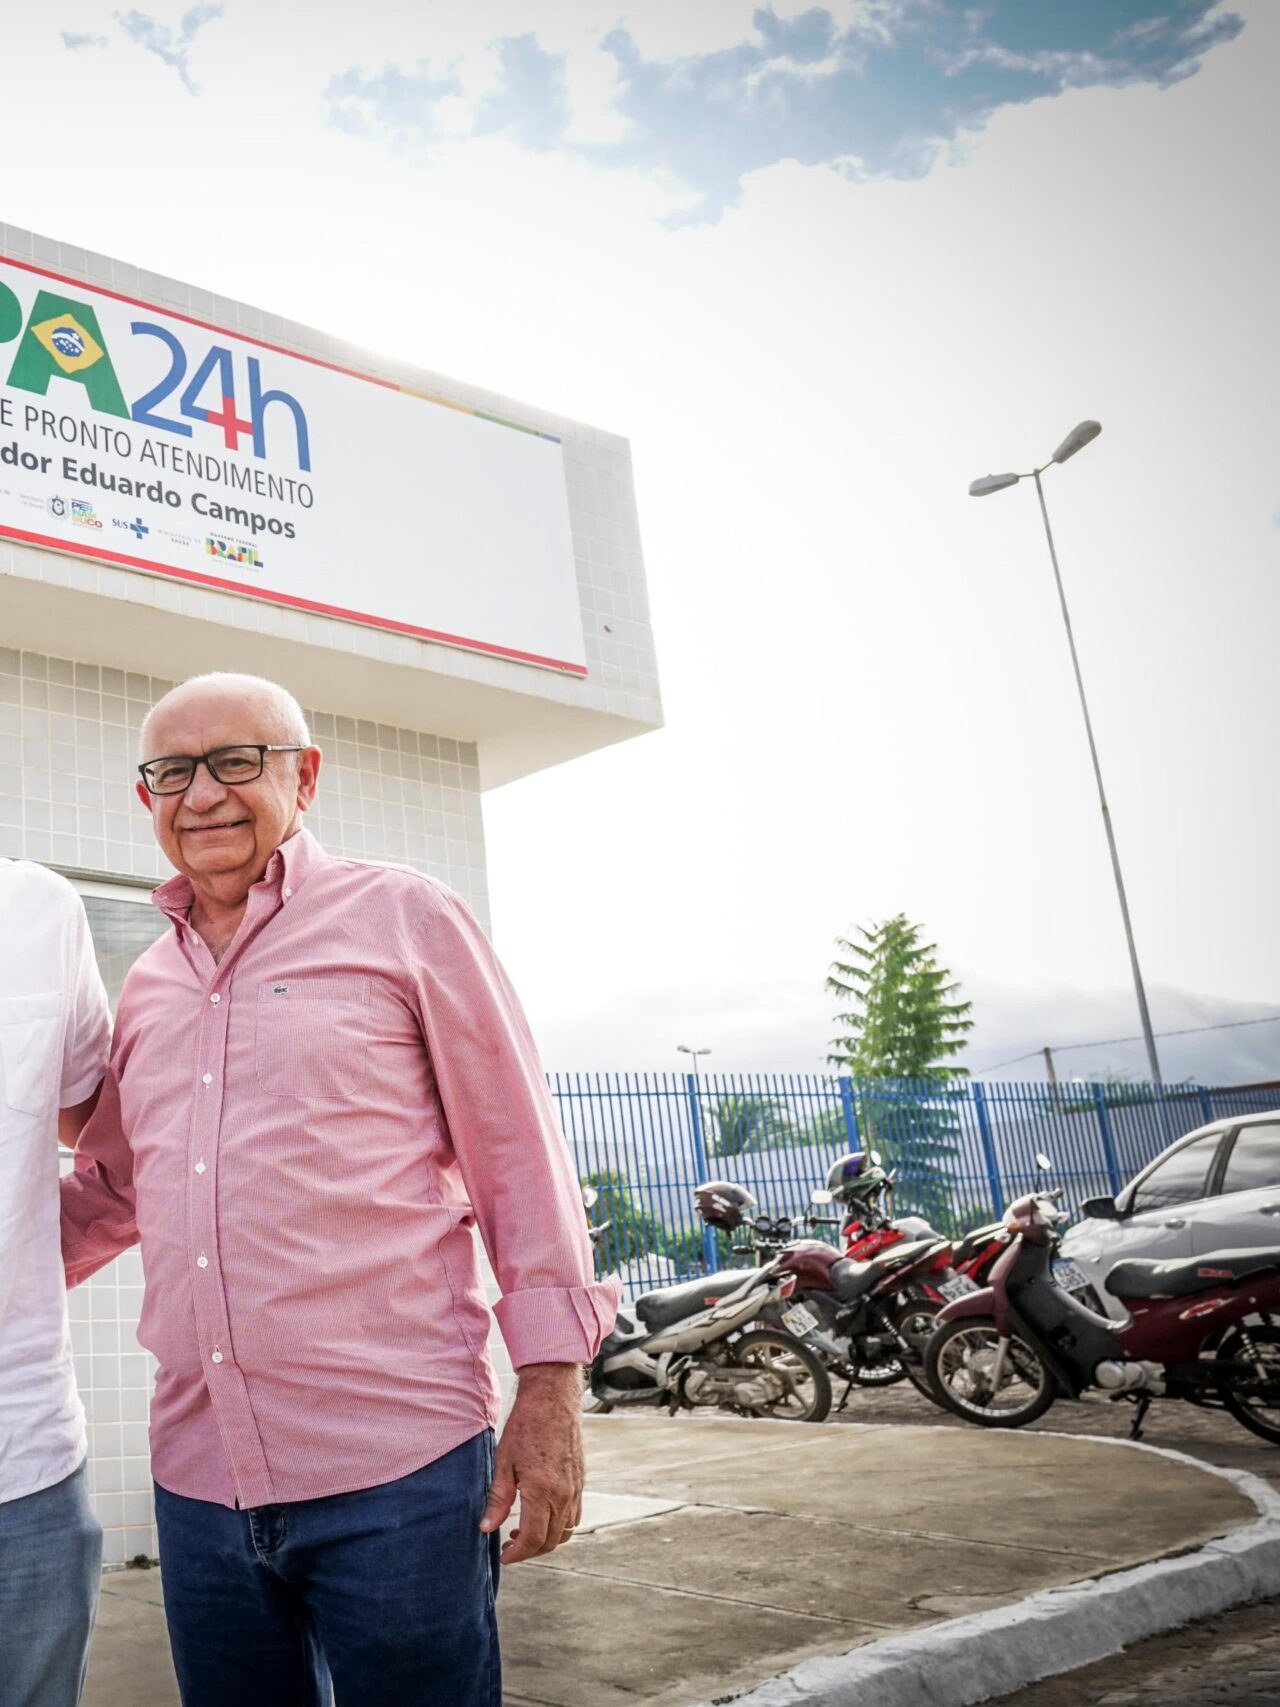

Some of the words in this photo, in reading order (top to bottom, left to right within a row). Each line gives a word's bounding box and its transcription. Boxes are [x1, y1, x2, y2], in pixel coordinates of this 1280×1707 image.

[131, 320, 312, 473] 24h
[24, 404, 132, 459] PRONTO
[140, 437, 315, 509] ATENDIMENTO
[62, 456, 182, 509] Eduardo
[190, 492, 297, 540] Campos
[111, 518, 129, 530] SUS
[205, 536, 264, 568] BRASIL
